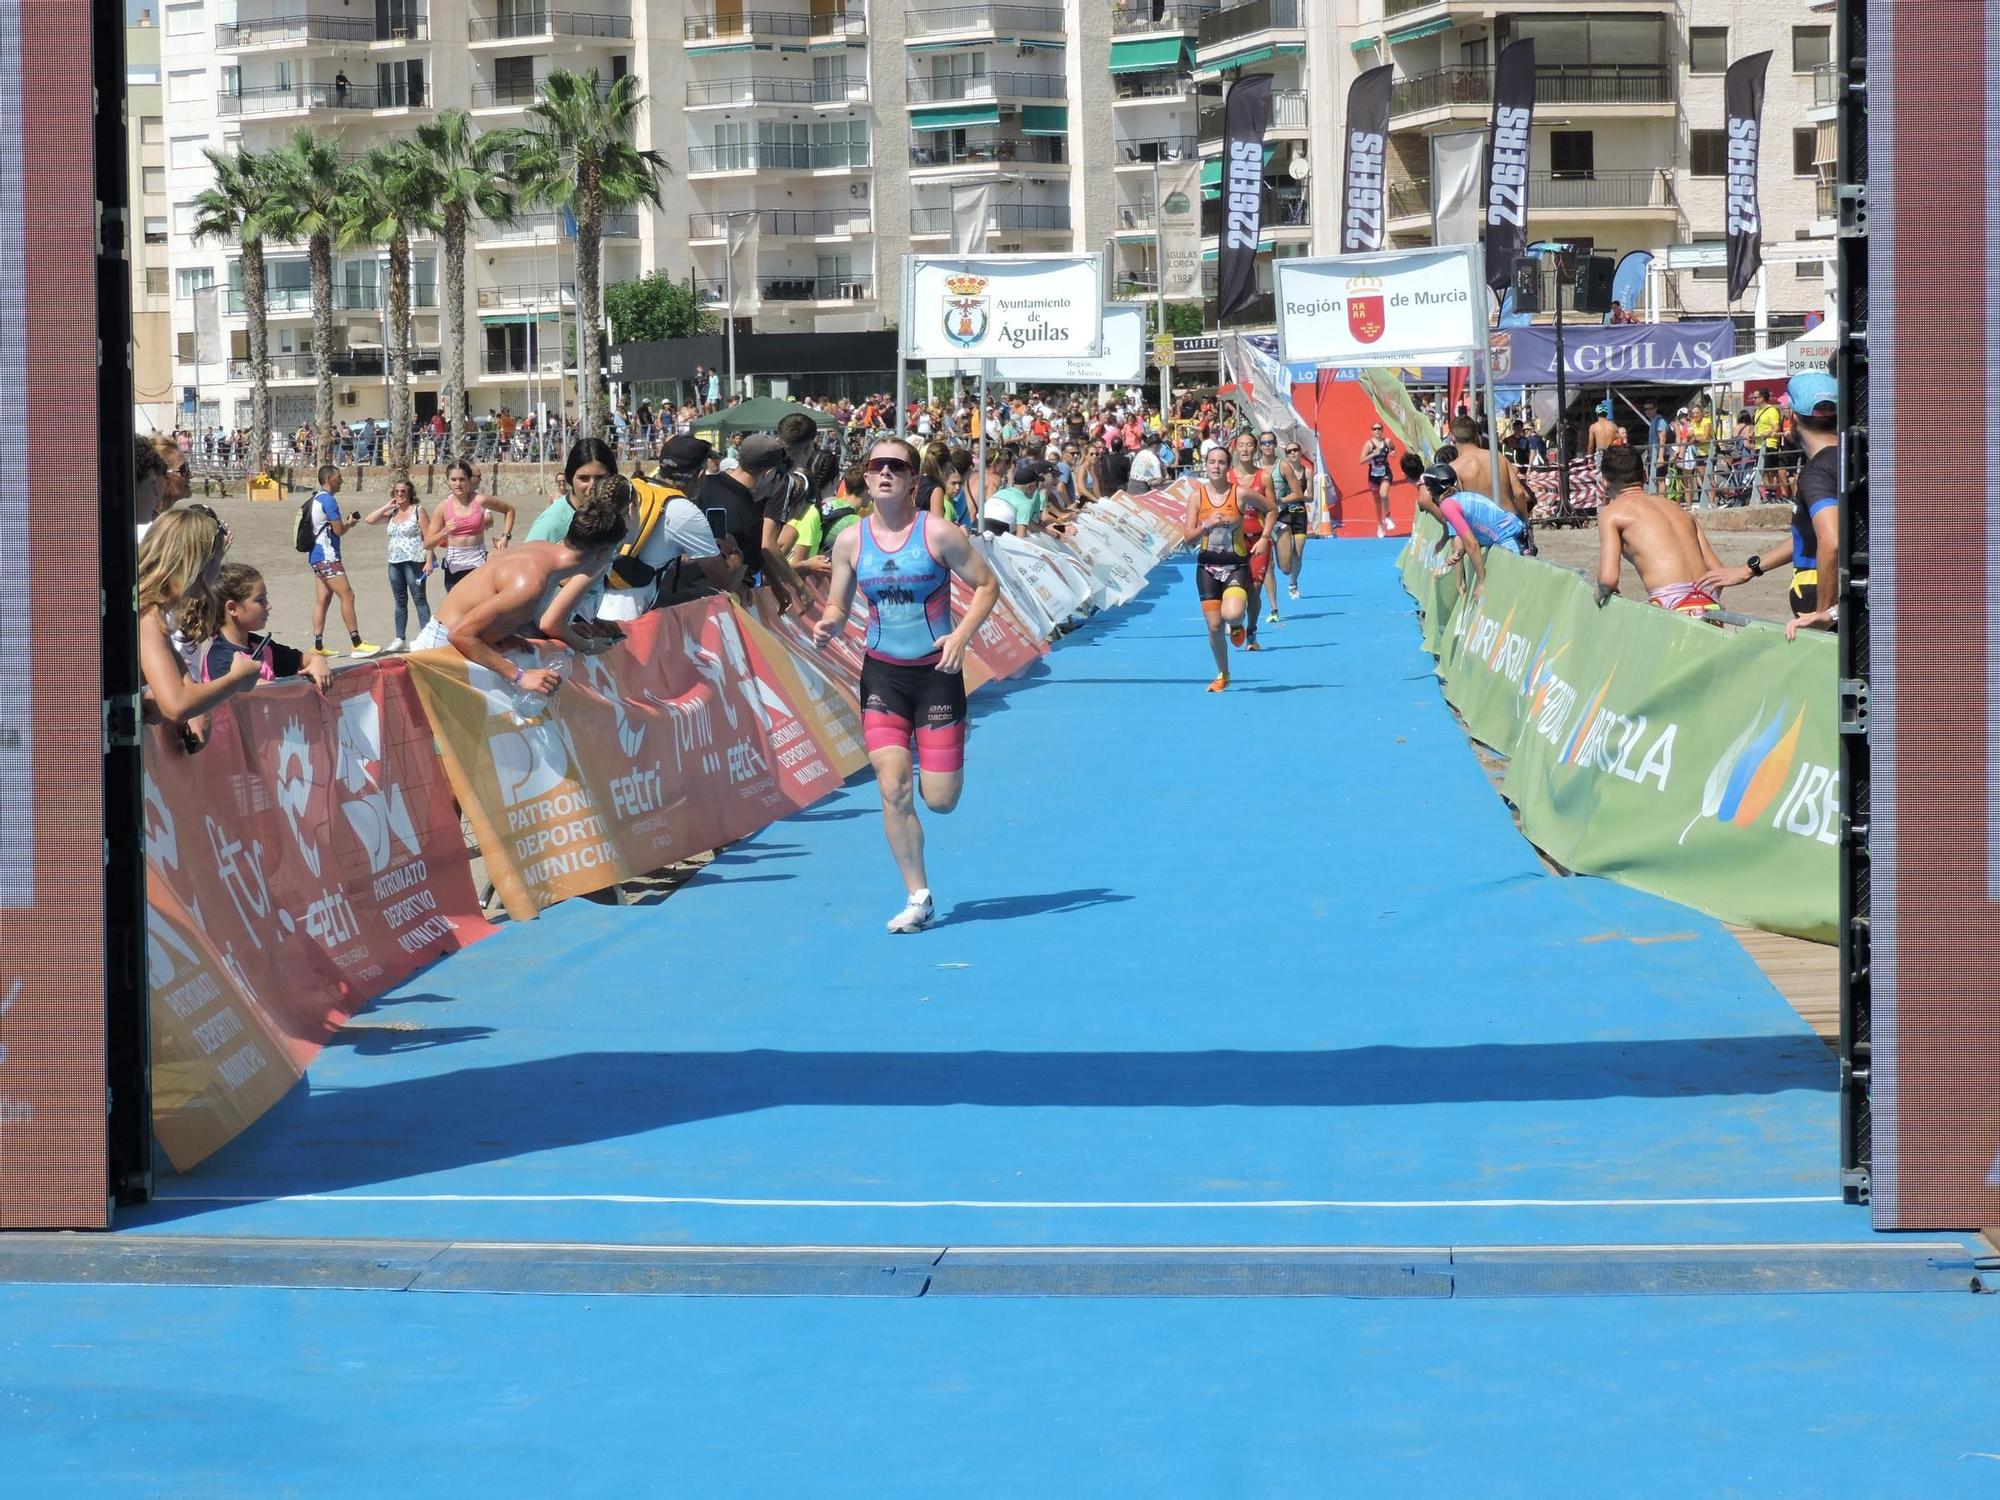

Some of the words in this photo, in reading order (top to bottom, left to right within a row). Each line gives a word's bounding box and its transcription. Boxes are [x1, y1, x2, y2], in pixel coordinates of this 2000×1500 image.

[1488, 106, 1530, 227] 226ERS
[1728, 117, 1758, 237] 226ERS
[1228, 140, 1263, 250] 226ERS
[1347, 131, 1383, 250] 226ERS
[997, 297, 1071, 315] Ayuntamiento
[1027, 310, 1041, 322] de
[1286, 299, 1341, 317] Región
[1390, 292, 1410, 308] de
[1414, 288, 1468, 305] Murcia
[998, 321, 1070, 349] Águilas
[1183, 339, 1217, 349] CAFETE
[1789, 361, 1805, 370] POR
[373, 860, 428, 902] PATRONATO
